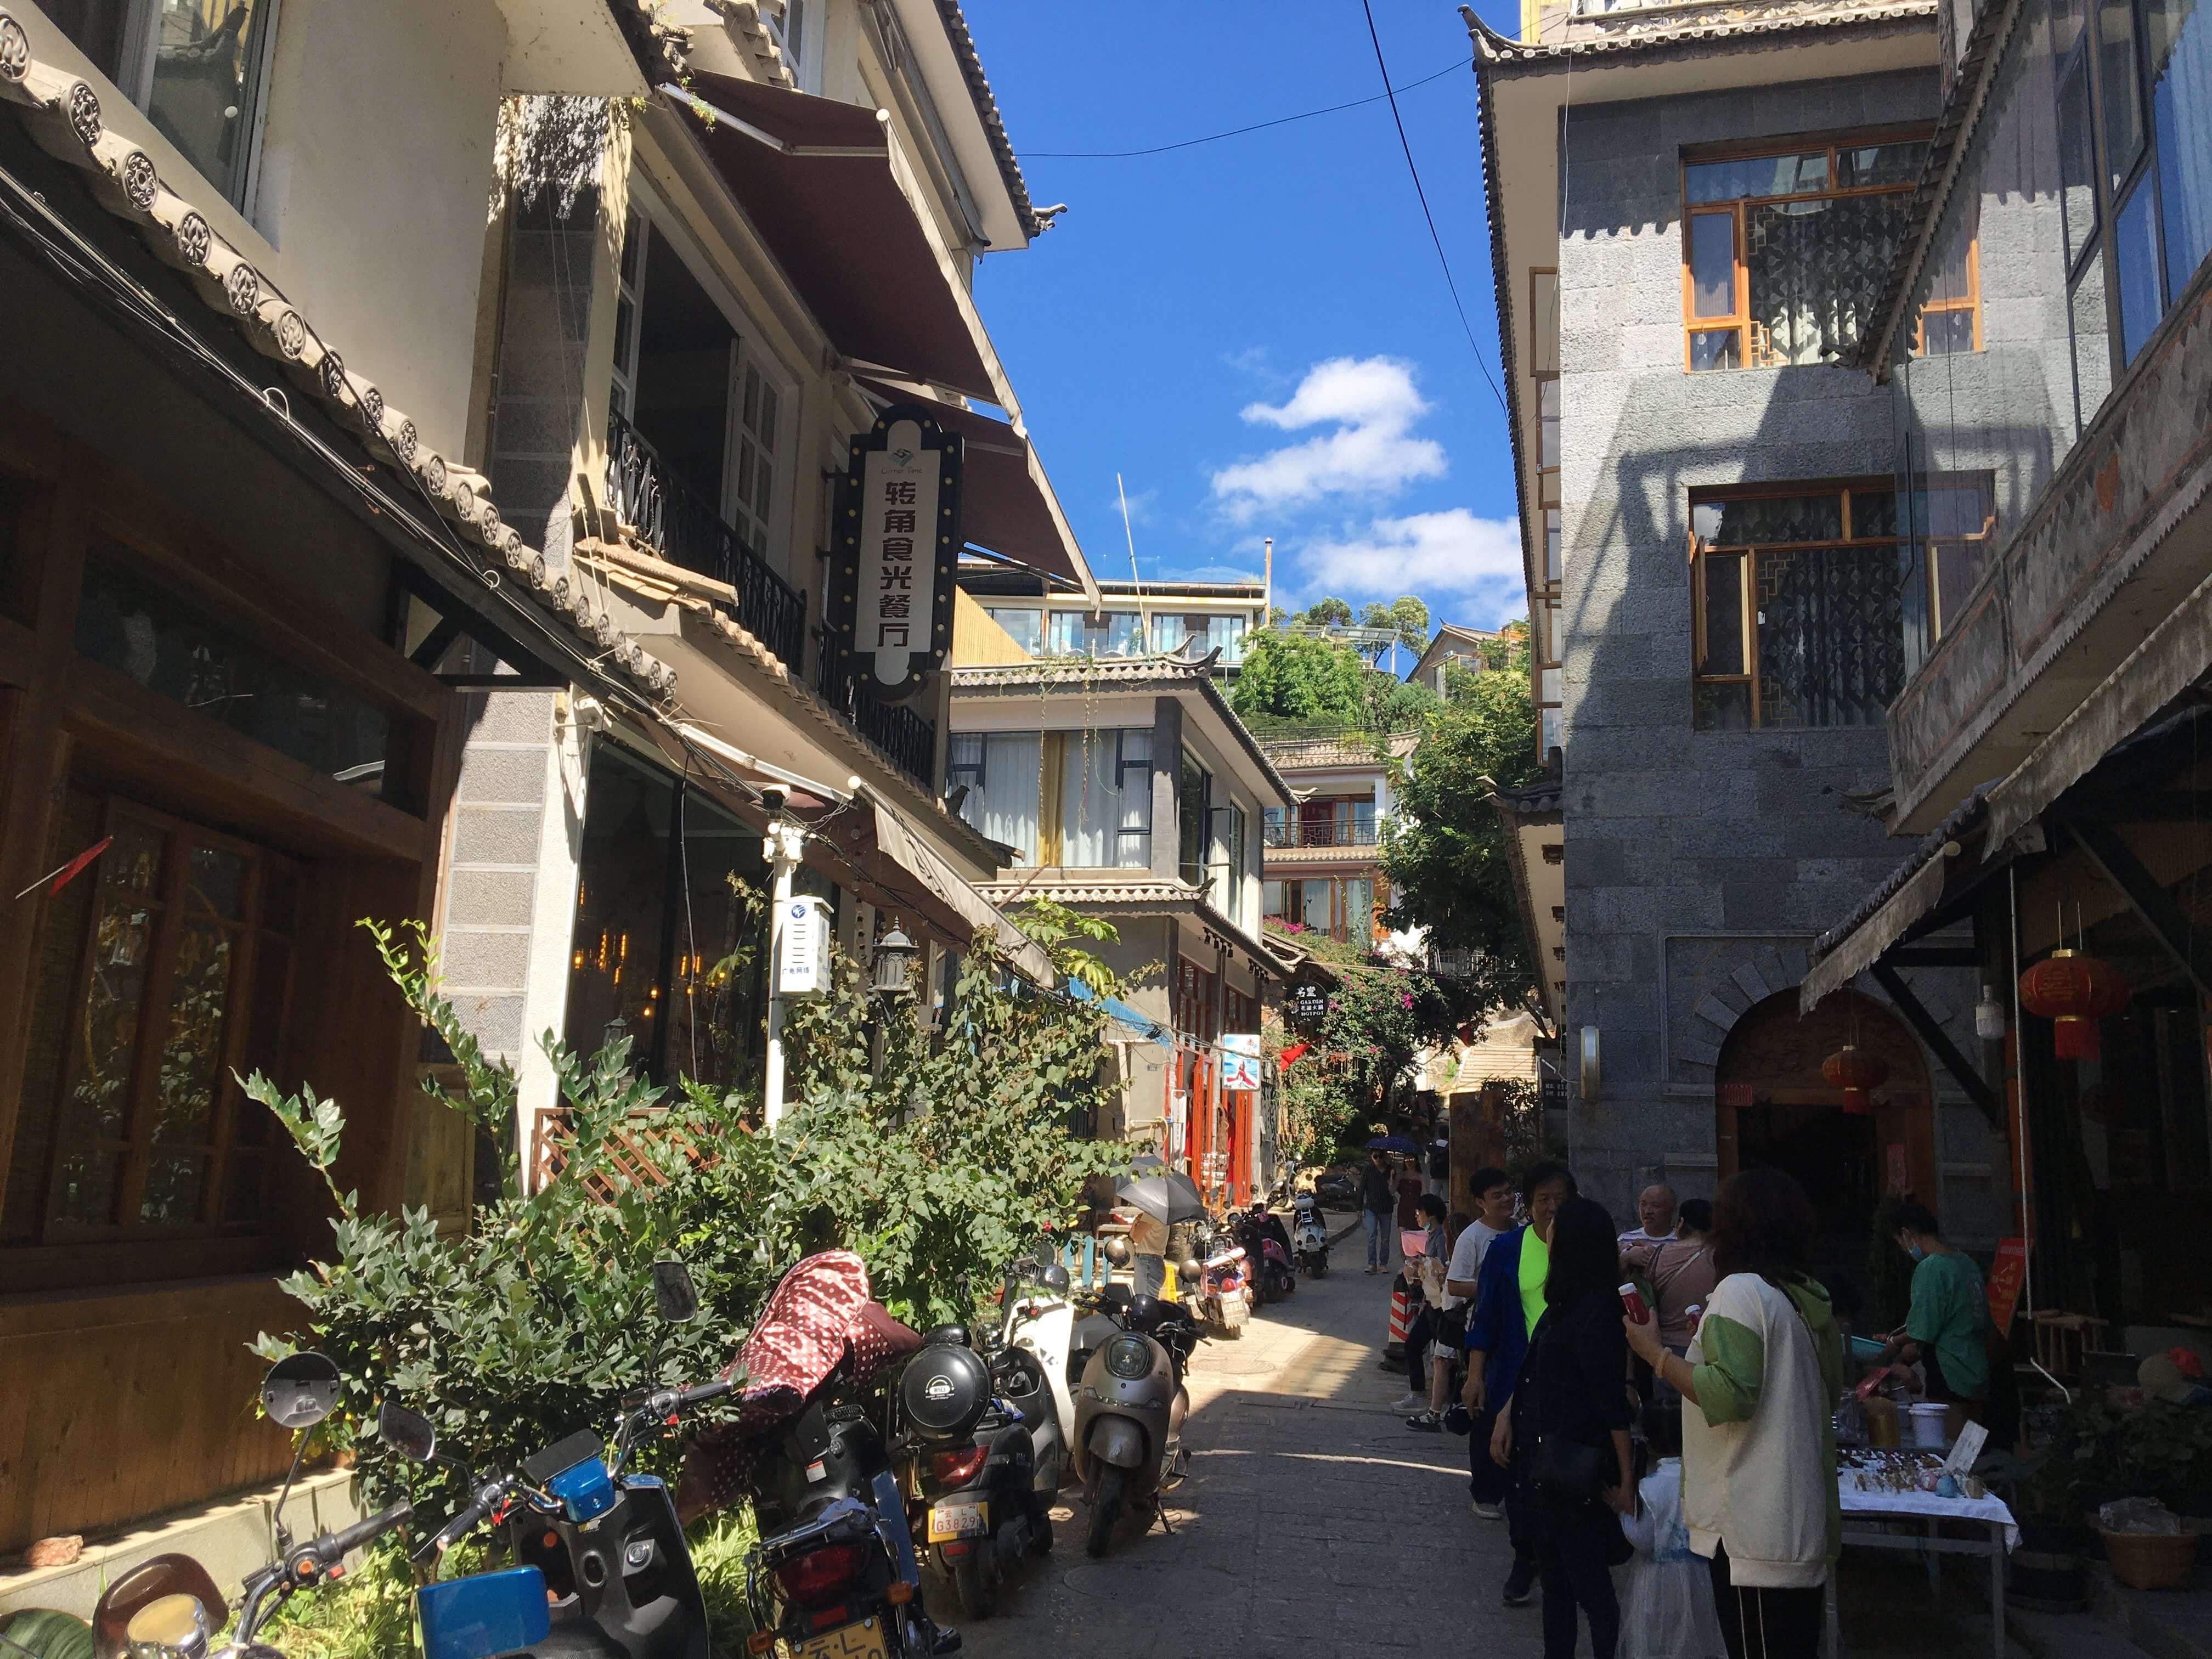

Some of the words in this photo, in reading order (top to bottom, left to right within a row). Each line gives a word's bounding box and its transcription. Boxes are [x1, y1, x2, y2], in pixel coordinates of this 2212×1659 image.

[877, 481, 916, 647] 转角食光餐厅
[782, 967, 810, 975] 广电网络
